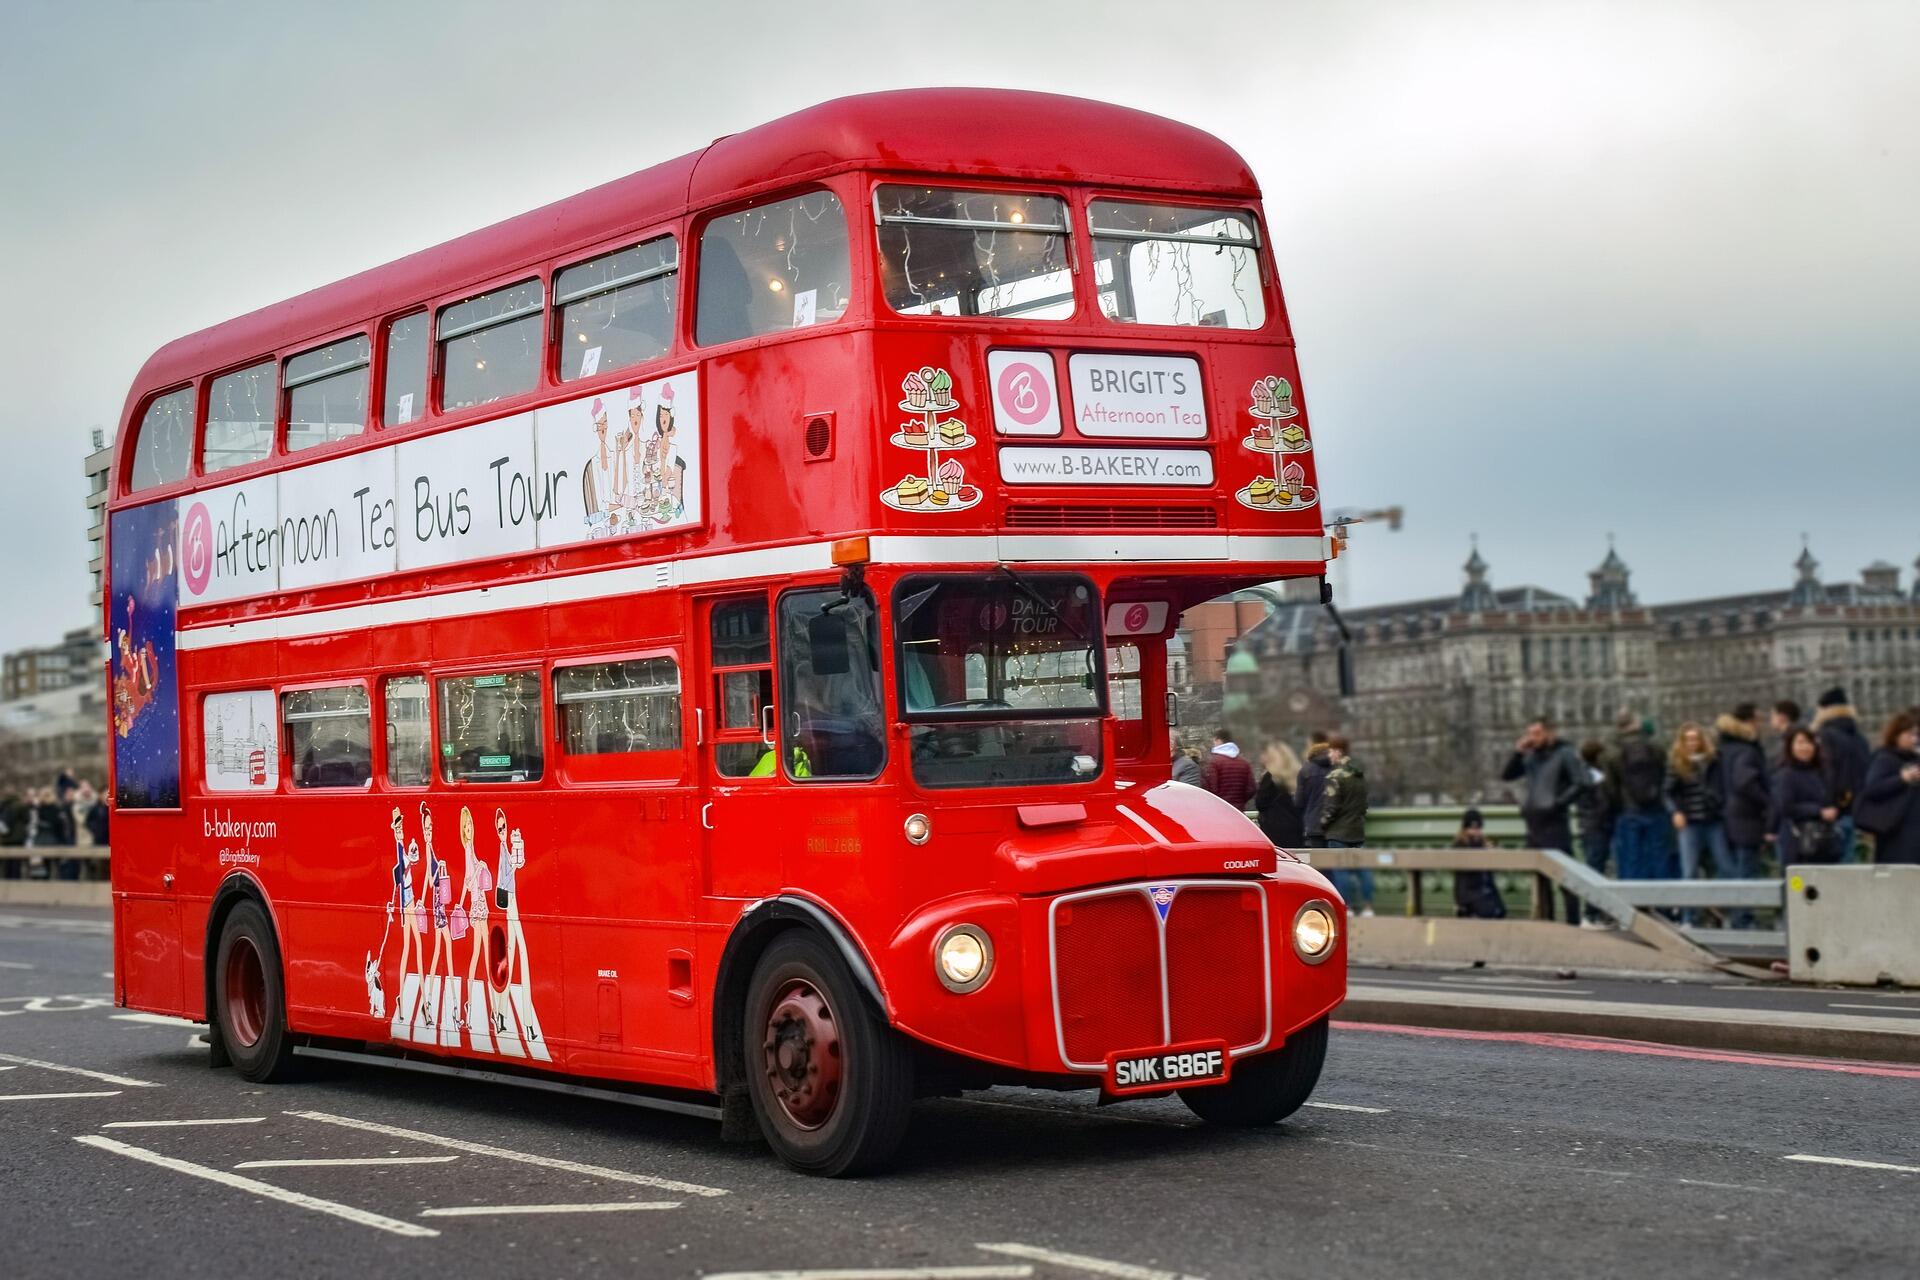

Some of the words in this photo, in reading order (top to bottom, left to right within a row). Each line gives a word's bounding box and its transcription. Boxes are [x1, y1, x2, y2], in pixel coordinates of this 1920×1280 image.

[1089, 368, 1187, 396] BRIGIT'S
[1081, 402, 1167, 424] Afternoon
[1169, 405, 1202, 425] Tea
[1013, 455, 1201, 478] www.B-BAKERY.com
[216, 491, 339, 577] Afternoon
[353, 486, 396, 553] Tea
[414, 475, 472, 542] Bus
[489, 456, 568, 529] Tour
[1012, 617, 1058, 633] TOUR
[204, 808, 277, 847] b-bakery.com
[1224, 859, 1260, 869] COOLANT
[1116, 1058, 1159, 1084] SMK
[1163, 1051, 1222, 1079] 686F
